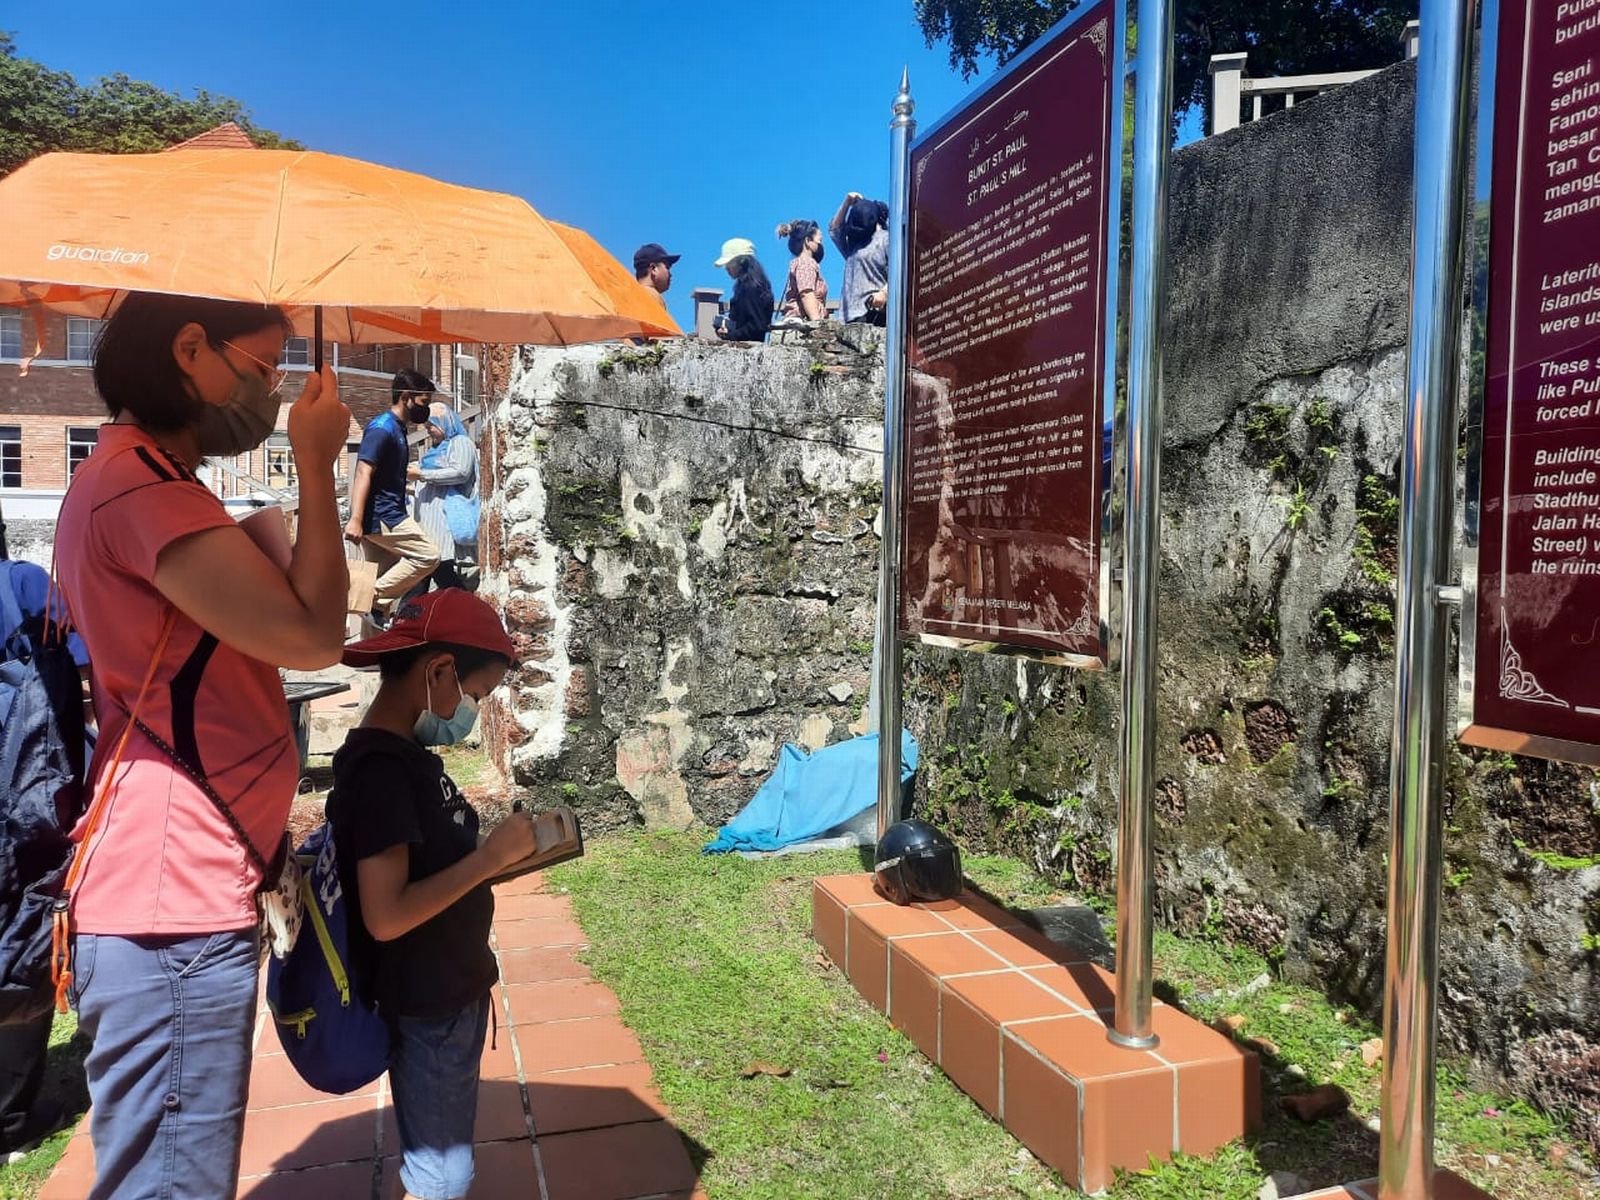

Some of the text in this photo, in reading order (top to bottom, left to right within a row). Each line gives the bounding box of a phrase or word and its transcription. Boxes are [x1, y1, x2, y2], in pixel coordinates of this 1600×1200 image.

[1557, 0, 1600, 21] Pula
[1552, 59, 1591, 88] Seni
[1549, 105, 1600, 134] Famo
[1548, 127, 1598, 156] besar
[968, 158, 991, 184] BUKIT
[1006, 134, 1028, 159] PAUL
[1546, 158, 1577, 177] Tan
[967, 189, 978, 207] ST.
[1008, 157, 1028, 179] HILL
[1543, 195, 1600, 223] zaman
[47, 244, 150, 266] guardian
[1541, 262, 1600, 290] Laterit
[1540, 286, 1600, 313] islands
[1540, 316, 1580, 335] were
[1540, 359, 1589, 378] These
[1537, 383, 1566, 400] like
[1536, 400, 1591, 422] forced
[1534, 468, 1596, 487] include
[1534, 491, 1600, 509] Stadthu
[1532, 514, 1577, 530] Jalan
[1532, 536, 1586, 556] Street)
[1531, 559, 1557, 574] the
